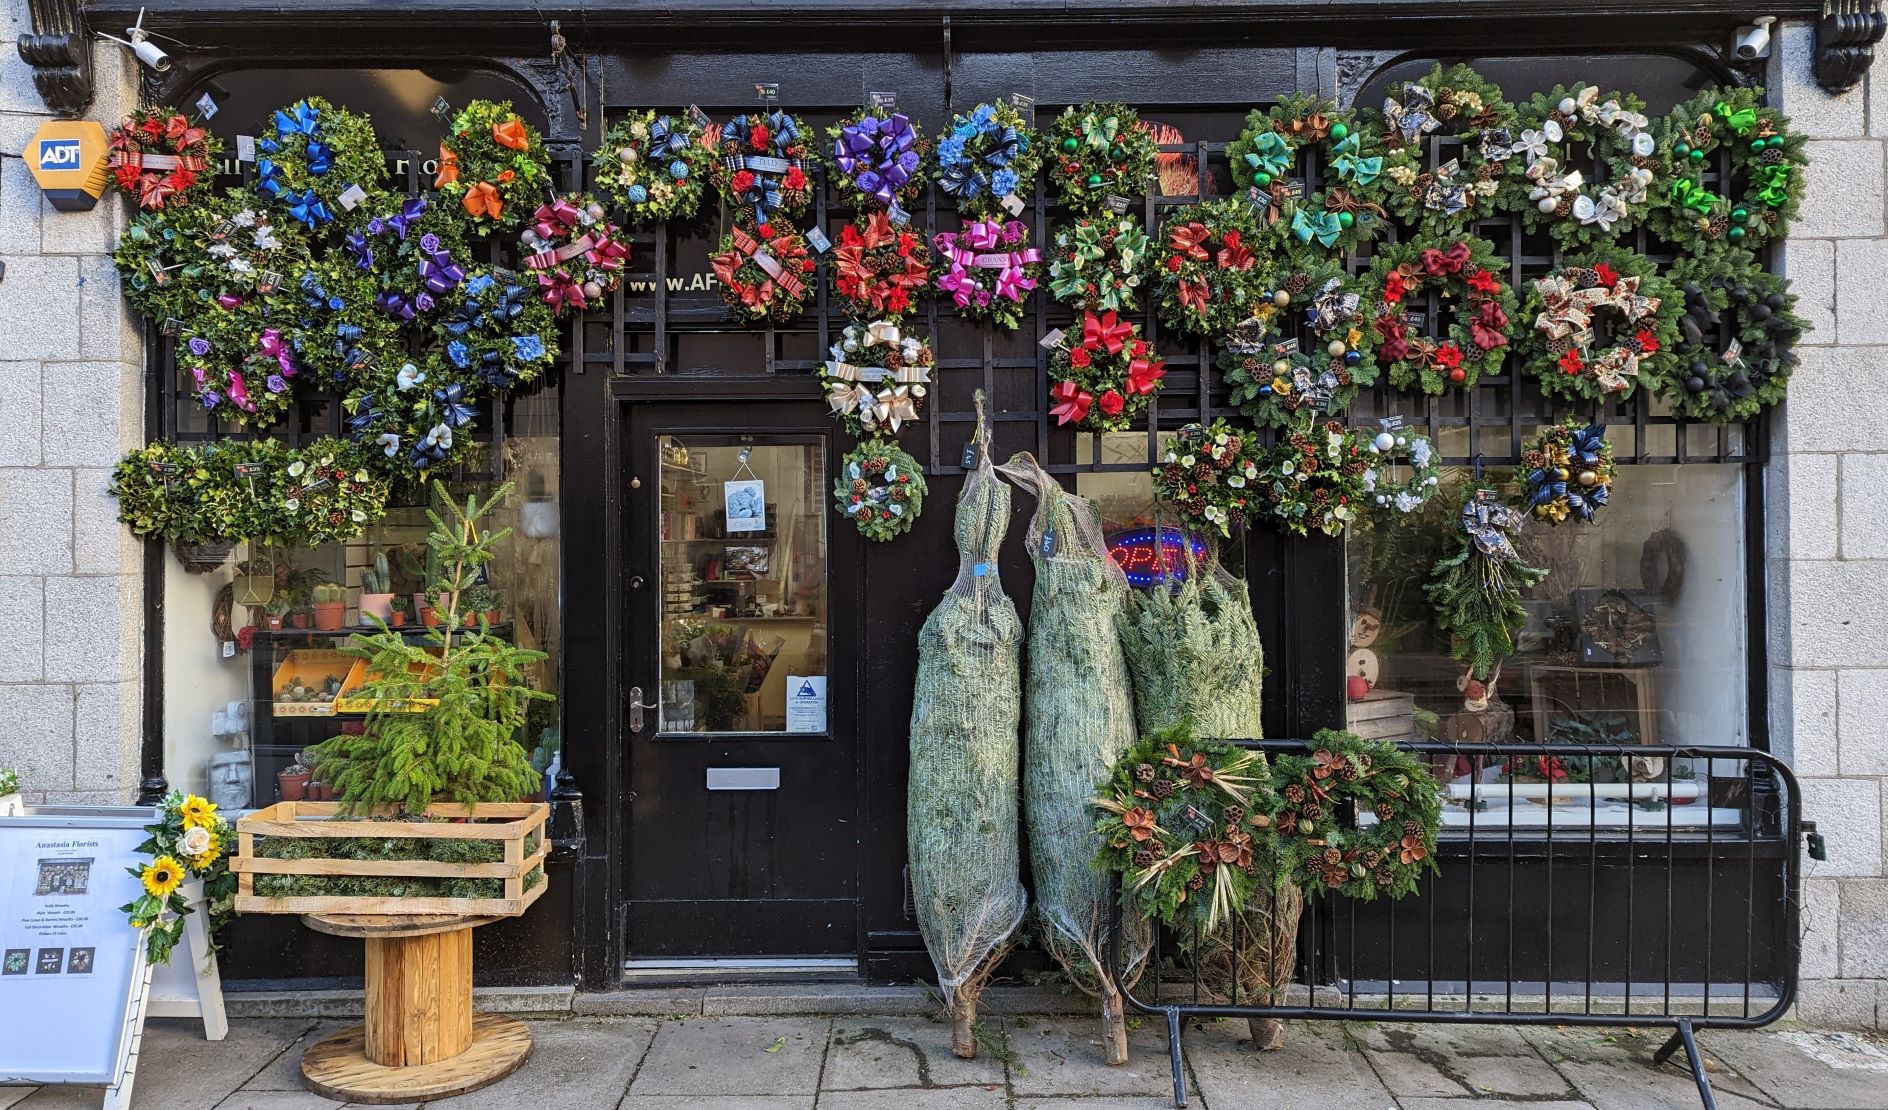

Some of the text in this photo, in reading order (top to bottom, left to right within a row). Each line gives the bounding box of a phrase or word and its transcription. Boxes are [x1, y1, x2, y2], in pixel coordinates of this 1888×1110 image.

[40, 146, 79, 164] ADT
[760, 159, 778, 167] DAD
[1257, 196, 1268, 205] £30
[268, 274, 276, 285] £30
[35, 840, 99, 849] Anastasia Florists
